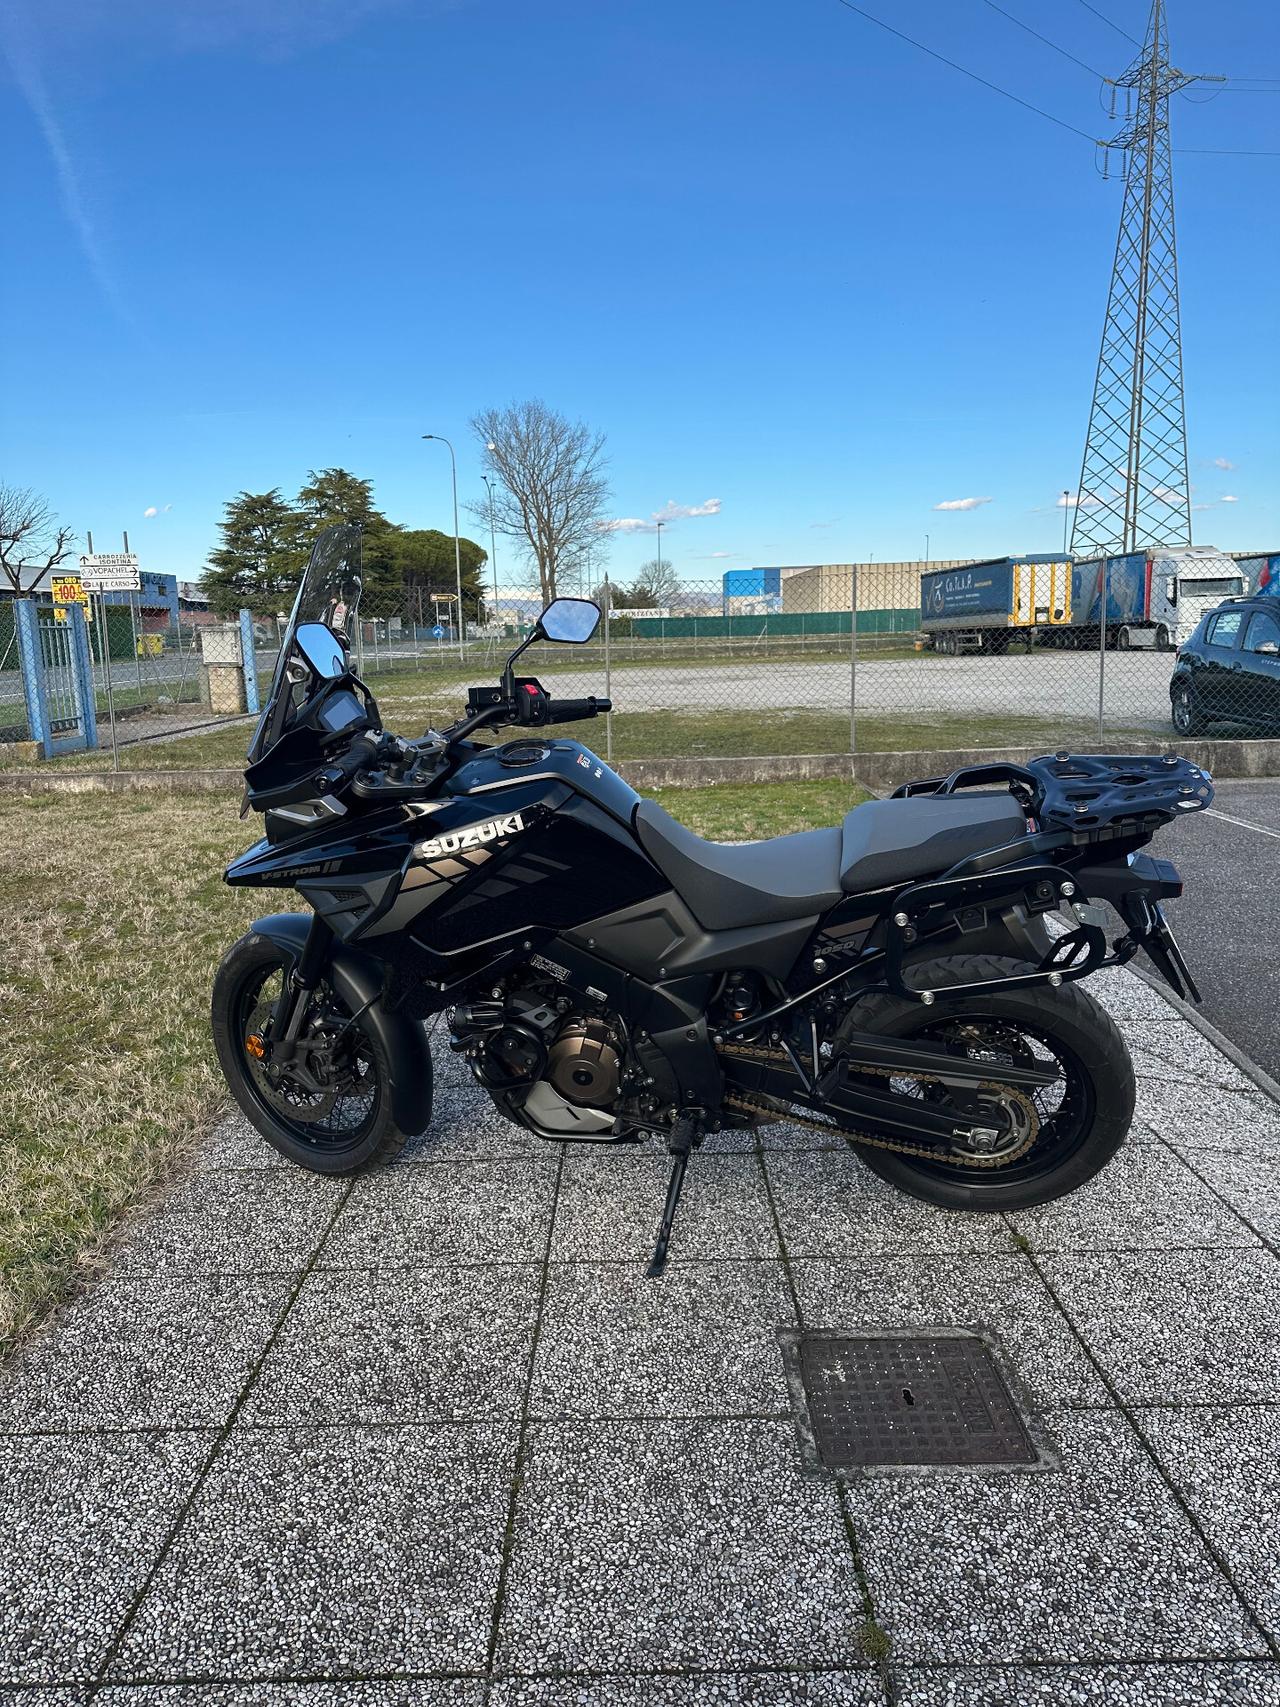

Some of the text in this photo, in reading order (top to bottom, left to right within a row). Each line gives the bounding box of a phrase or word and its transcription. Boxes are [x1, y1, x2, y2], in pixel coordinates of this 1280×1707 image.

[421, 814, 524, 858] SUZUKI
[261, 865, 321, 880] V-STROM
[814, 941, 855, 957] 1050
